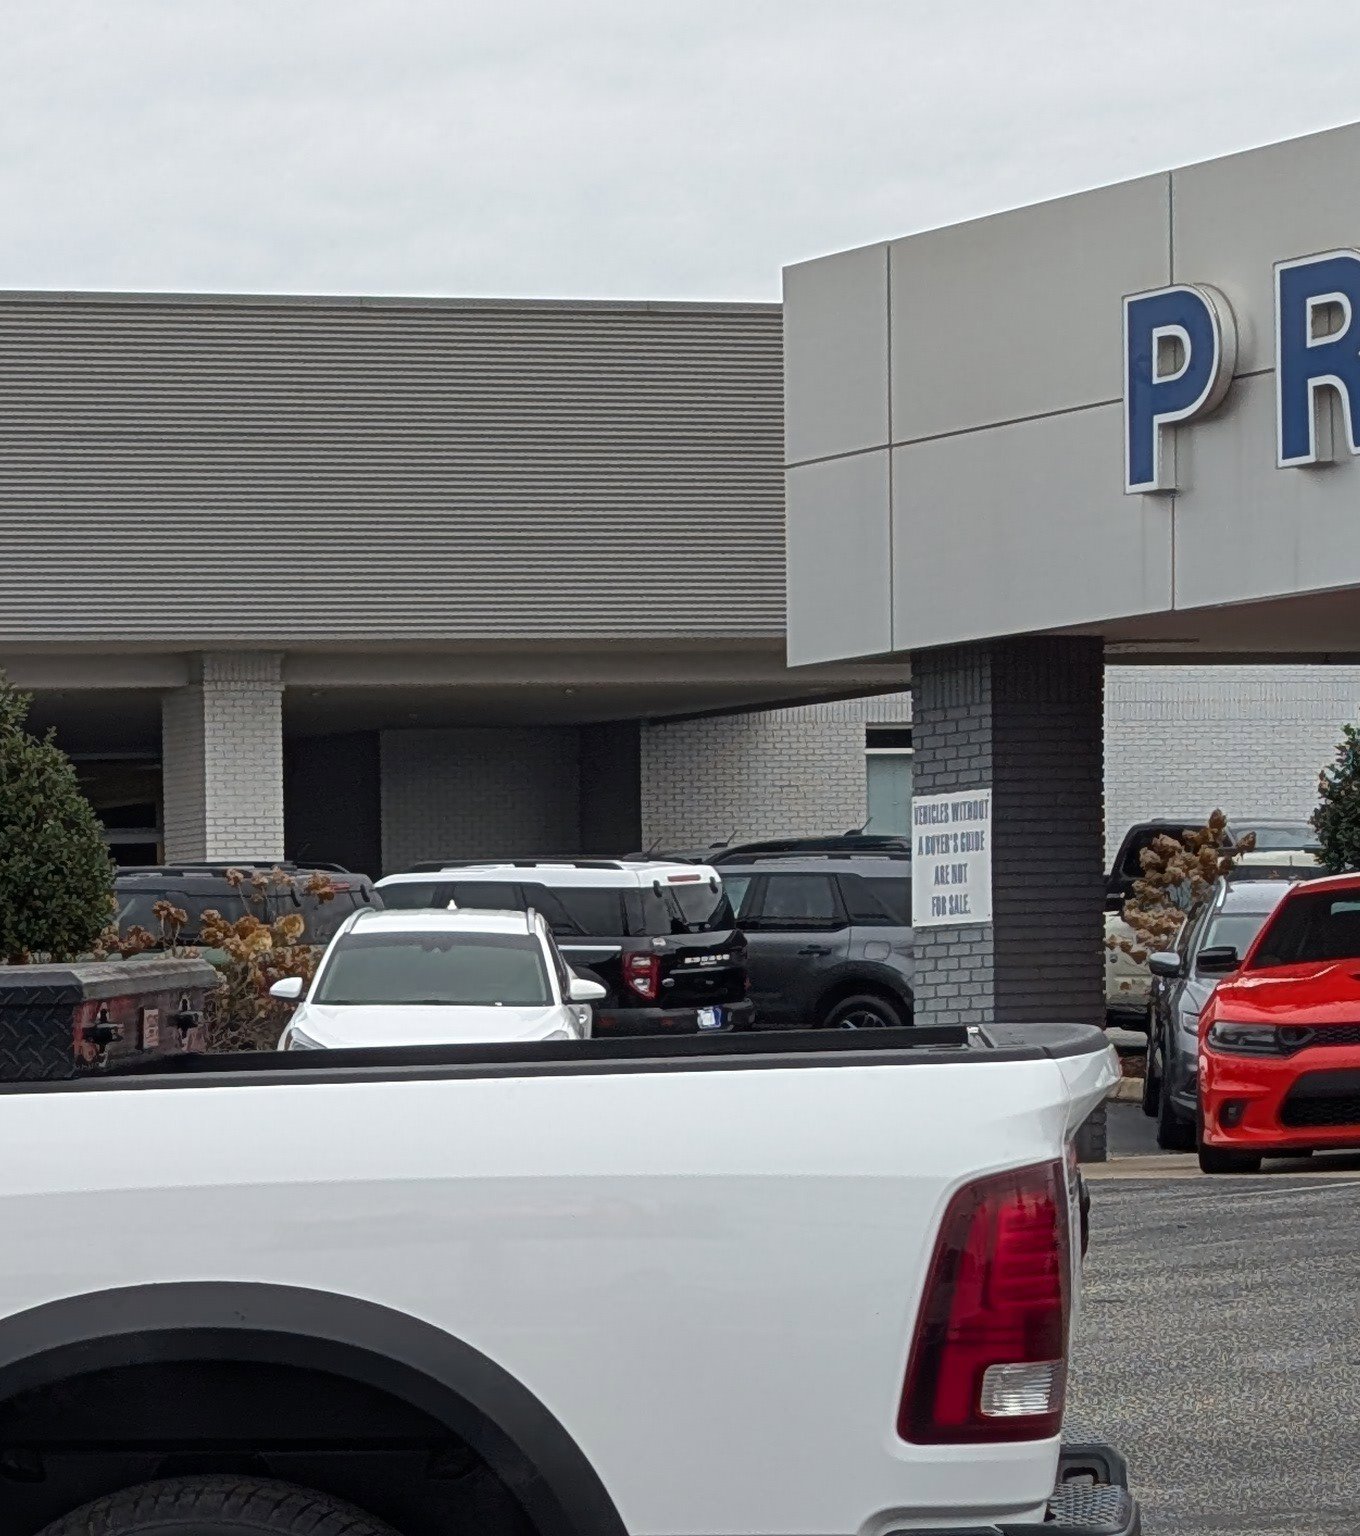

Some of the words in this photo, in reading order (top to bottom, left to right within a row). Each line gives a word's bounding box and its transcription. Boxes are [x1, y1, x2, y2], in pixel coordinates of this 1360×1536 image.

[914, 803, 949, 826] VEHICLES
[951, 799, 989, 822] WITHOUT
[918, 836, 923, 855] A
[925, 833, 959, 855] BUYER'S
[960, 830, 985, 852] GUIDE
[934, 865, 950, 886] ARE
[951, 863, 968, 885] NOT
[932, 895, 947, 917] FOR
[948, 894, 971, 915] SALE.
